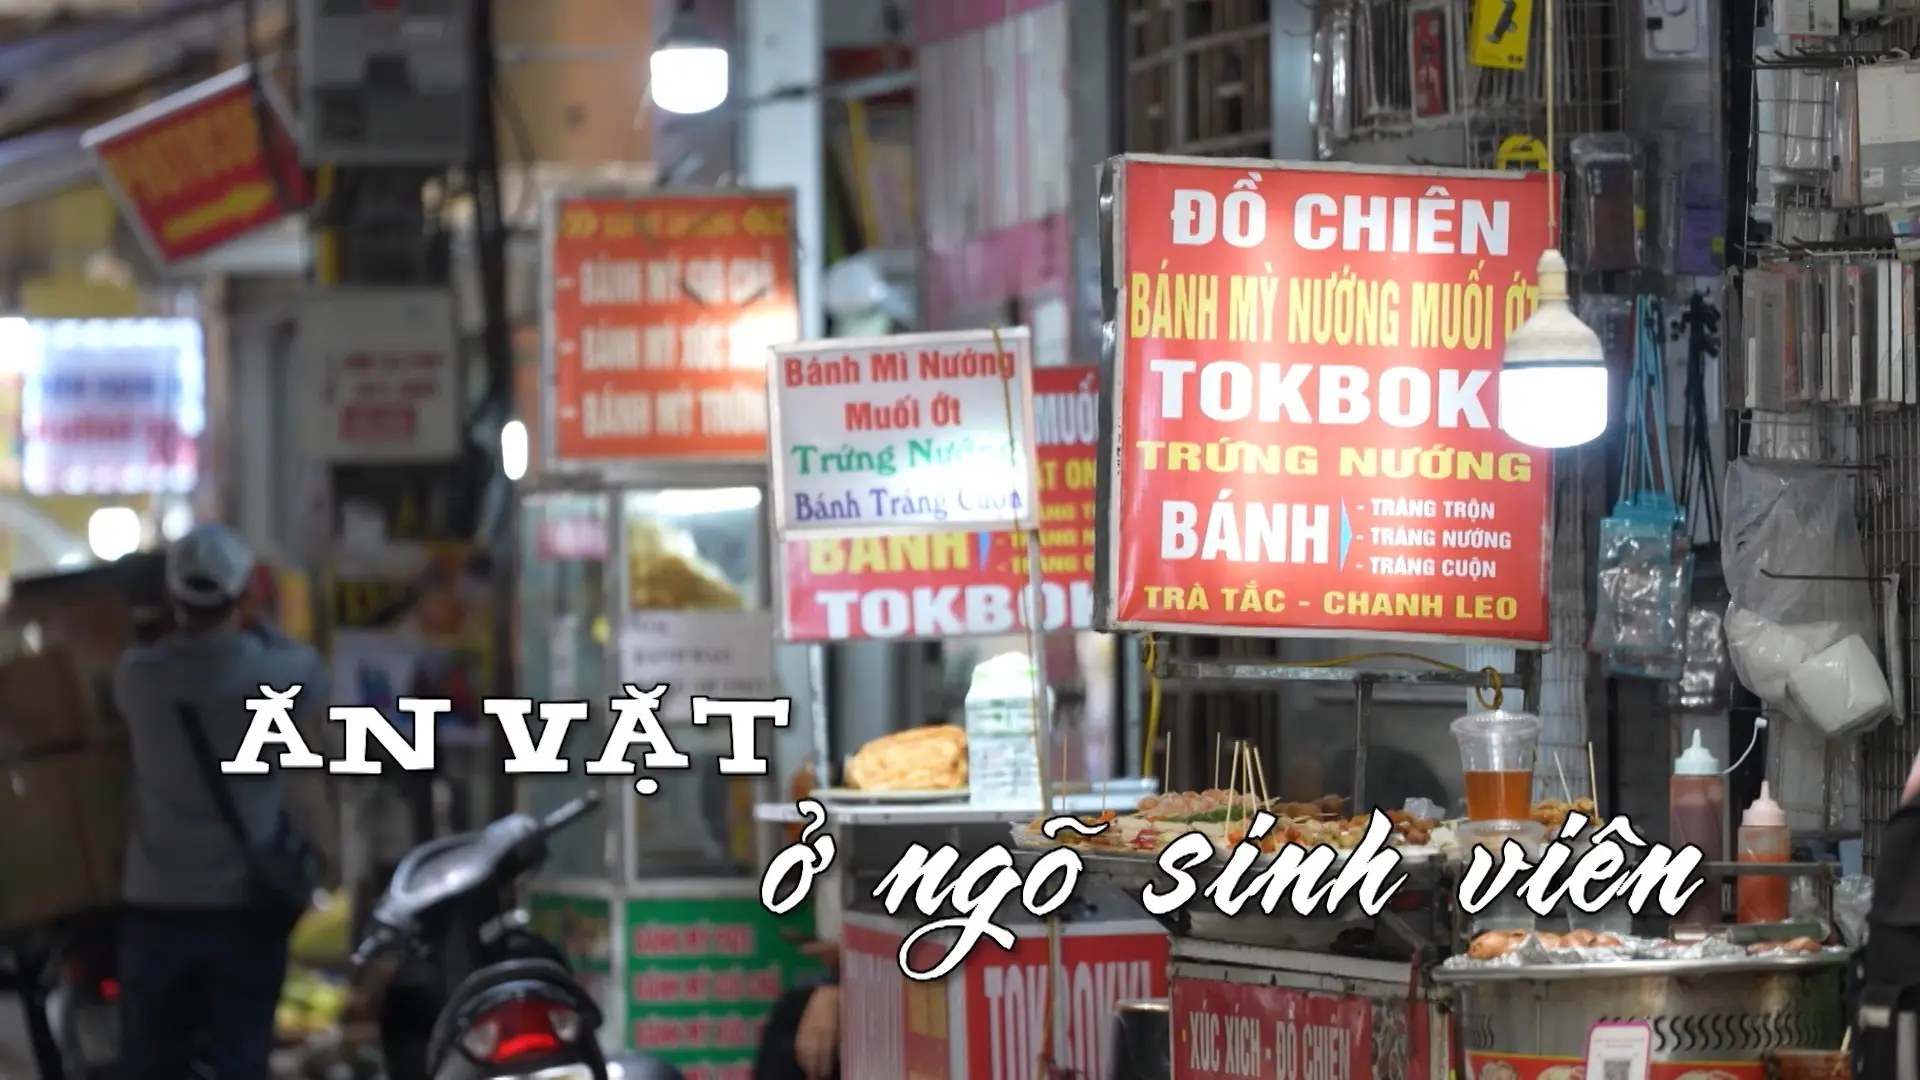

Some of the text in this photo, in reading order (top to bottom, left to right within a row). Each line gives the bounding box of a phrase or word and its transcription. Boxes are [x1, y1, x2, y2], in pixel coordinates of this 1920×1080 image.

[1170, 172, 1510, 256] ĐỒ CHIÊN
[1131, 258, 1219, 341] BÁNH
[1229, 261, 1279, 343] MỲ
[1288, 264, 1399, 348] NƯỚNG
[1411, 259, 1493, 350] MUỐI
[785, 349, 1015, 387] Bánh Mì Nướng
[845, 391, 961, 431] Muối Ớt
[1150, 360, 1503, 429] TOKBOK
[791, 443, 896, 475] Trứng
[1136, 436, 1318, 476] TRỨNG
[1339, 446, 1532, 482] NƯỚNG
[793, 490, 861, 521] Bánh
[1442, 497, 1495, 523] TRỘN
[1161, 489, 1329, 564] BÁNH
[1442, 527, 1512, 549] NƯỚNG
[1442, 556, 1497, 582] CUỘN
[1144, 579, 1518, 621] TRÀ TẮC CHANH LEO
[1189, 1000, 1220, 1073] XÚC
[1224, 1003, 1261, 1078] XÍCH
[1302, 1013, 1351, 1080] CHIÊN
